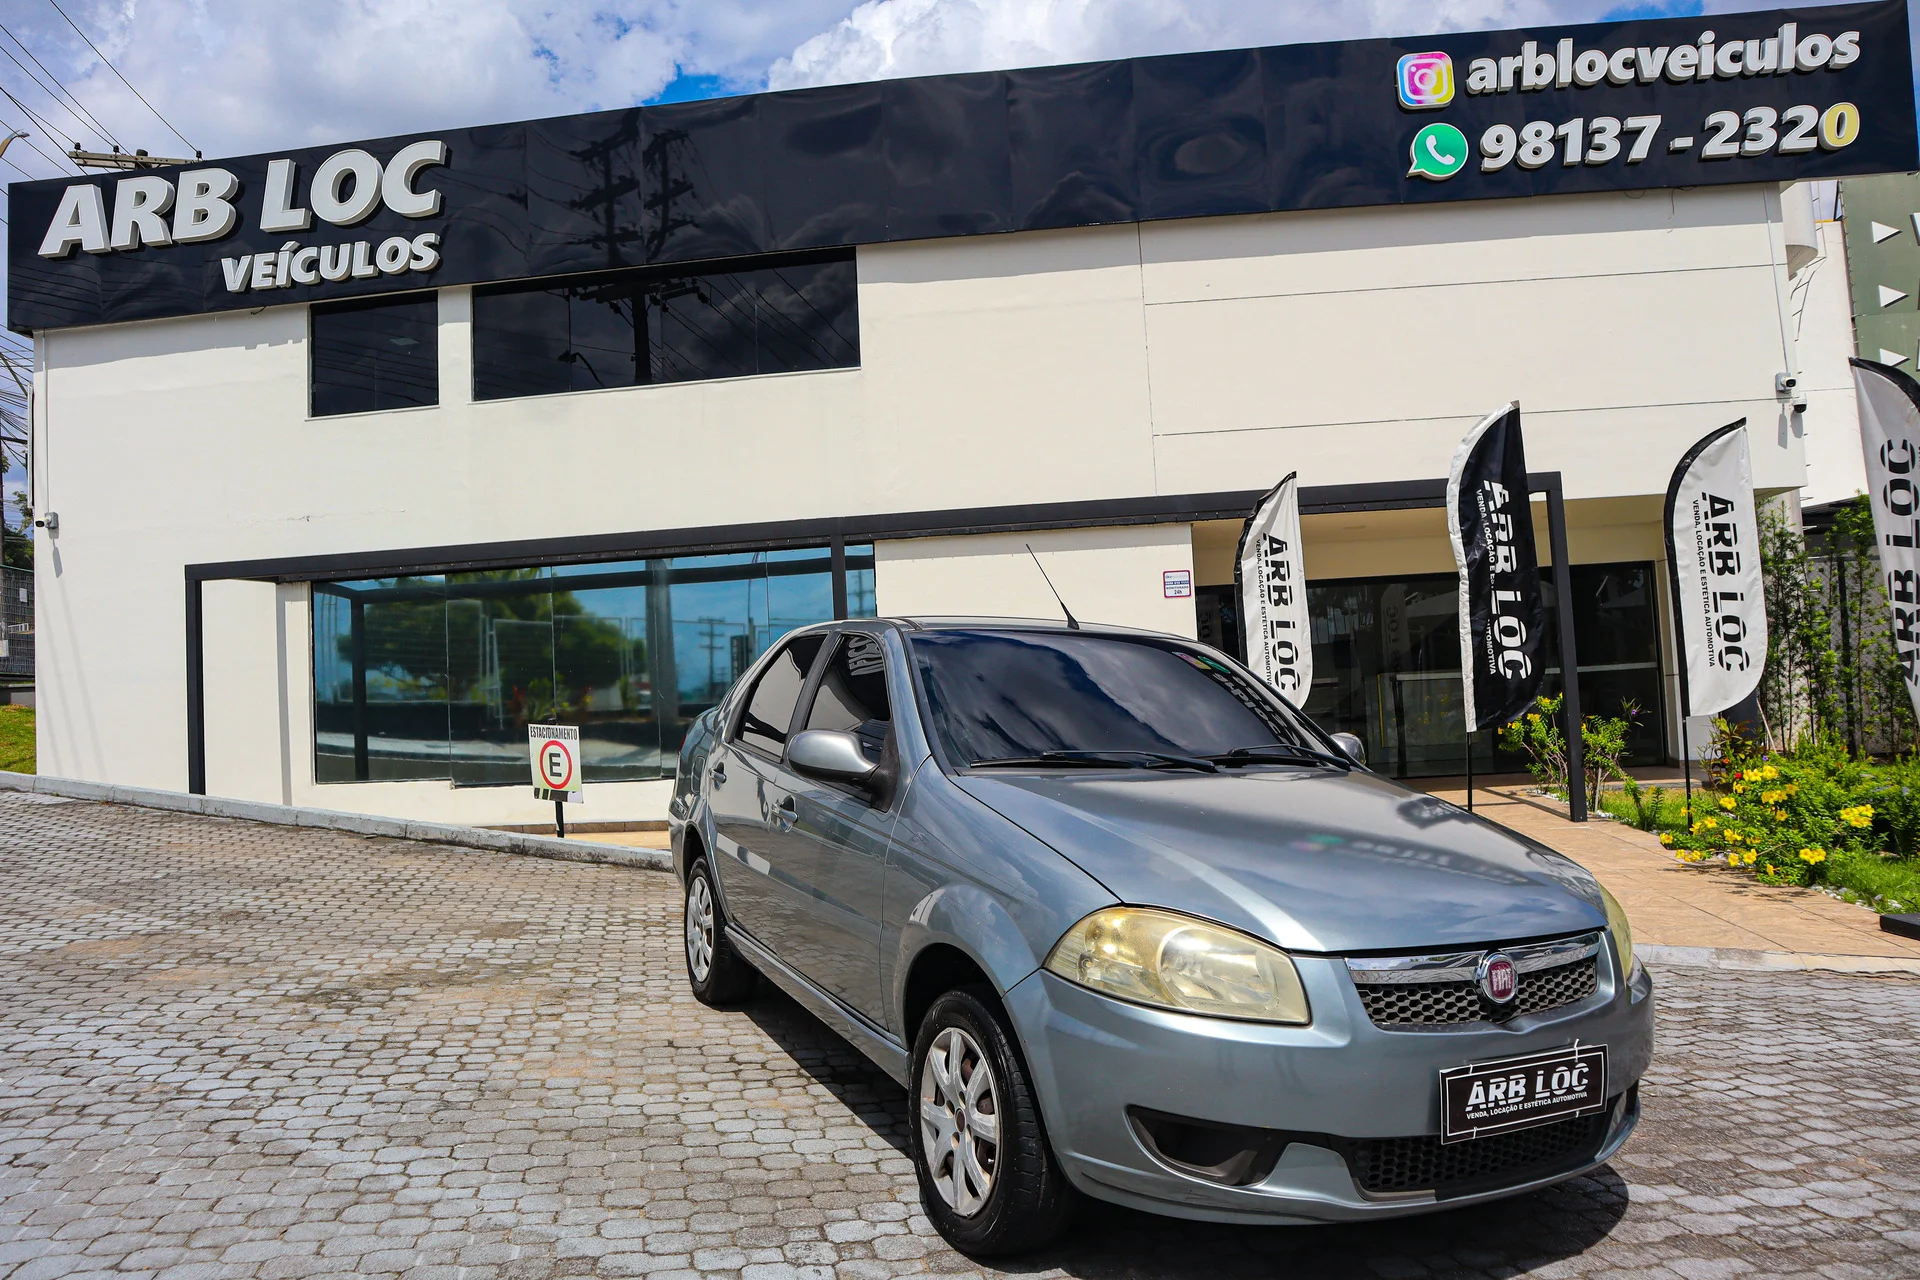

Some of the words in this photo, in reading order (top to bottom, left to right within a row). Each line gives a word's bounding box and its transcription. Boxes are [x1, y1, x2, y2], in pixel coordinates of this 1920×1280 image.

[1465, 22, 1861, 95] arblocveiculos
[1480, 114, 1662, 172] 98137
[1701, 102, 1861, 160] 2320
[38, 167, 239, 258] ARB
[260, 140, 448, 233] LOC
[221, 232, 441, 293] VEÍCULOS
[1484, 480, 1517, 573] ARB
[1880, 438, 1920, 548] LOC
[1263, 532, 1293, 607] ARB
[1702, 491, 1741, 576] ARB
[1270, 620, 1301, 691] LOC
[1491, 590, 1533, 680] LOC
[1705, 616, 1715, 667] AUTOMOTIVA
[1712, 592, 1750, 671] LOC
[530, 726, 578, 740] ESTACIONAMENTO
[549, 752, 562, 777] E
[1465, 1073, 1527, 1111] ARB
[1535, 1062, 1590, 1099] LOC
[1552, 1091, 1588, 1104] AUTOMOTIVA
